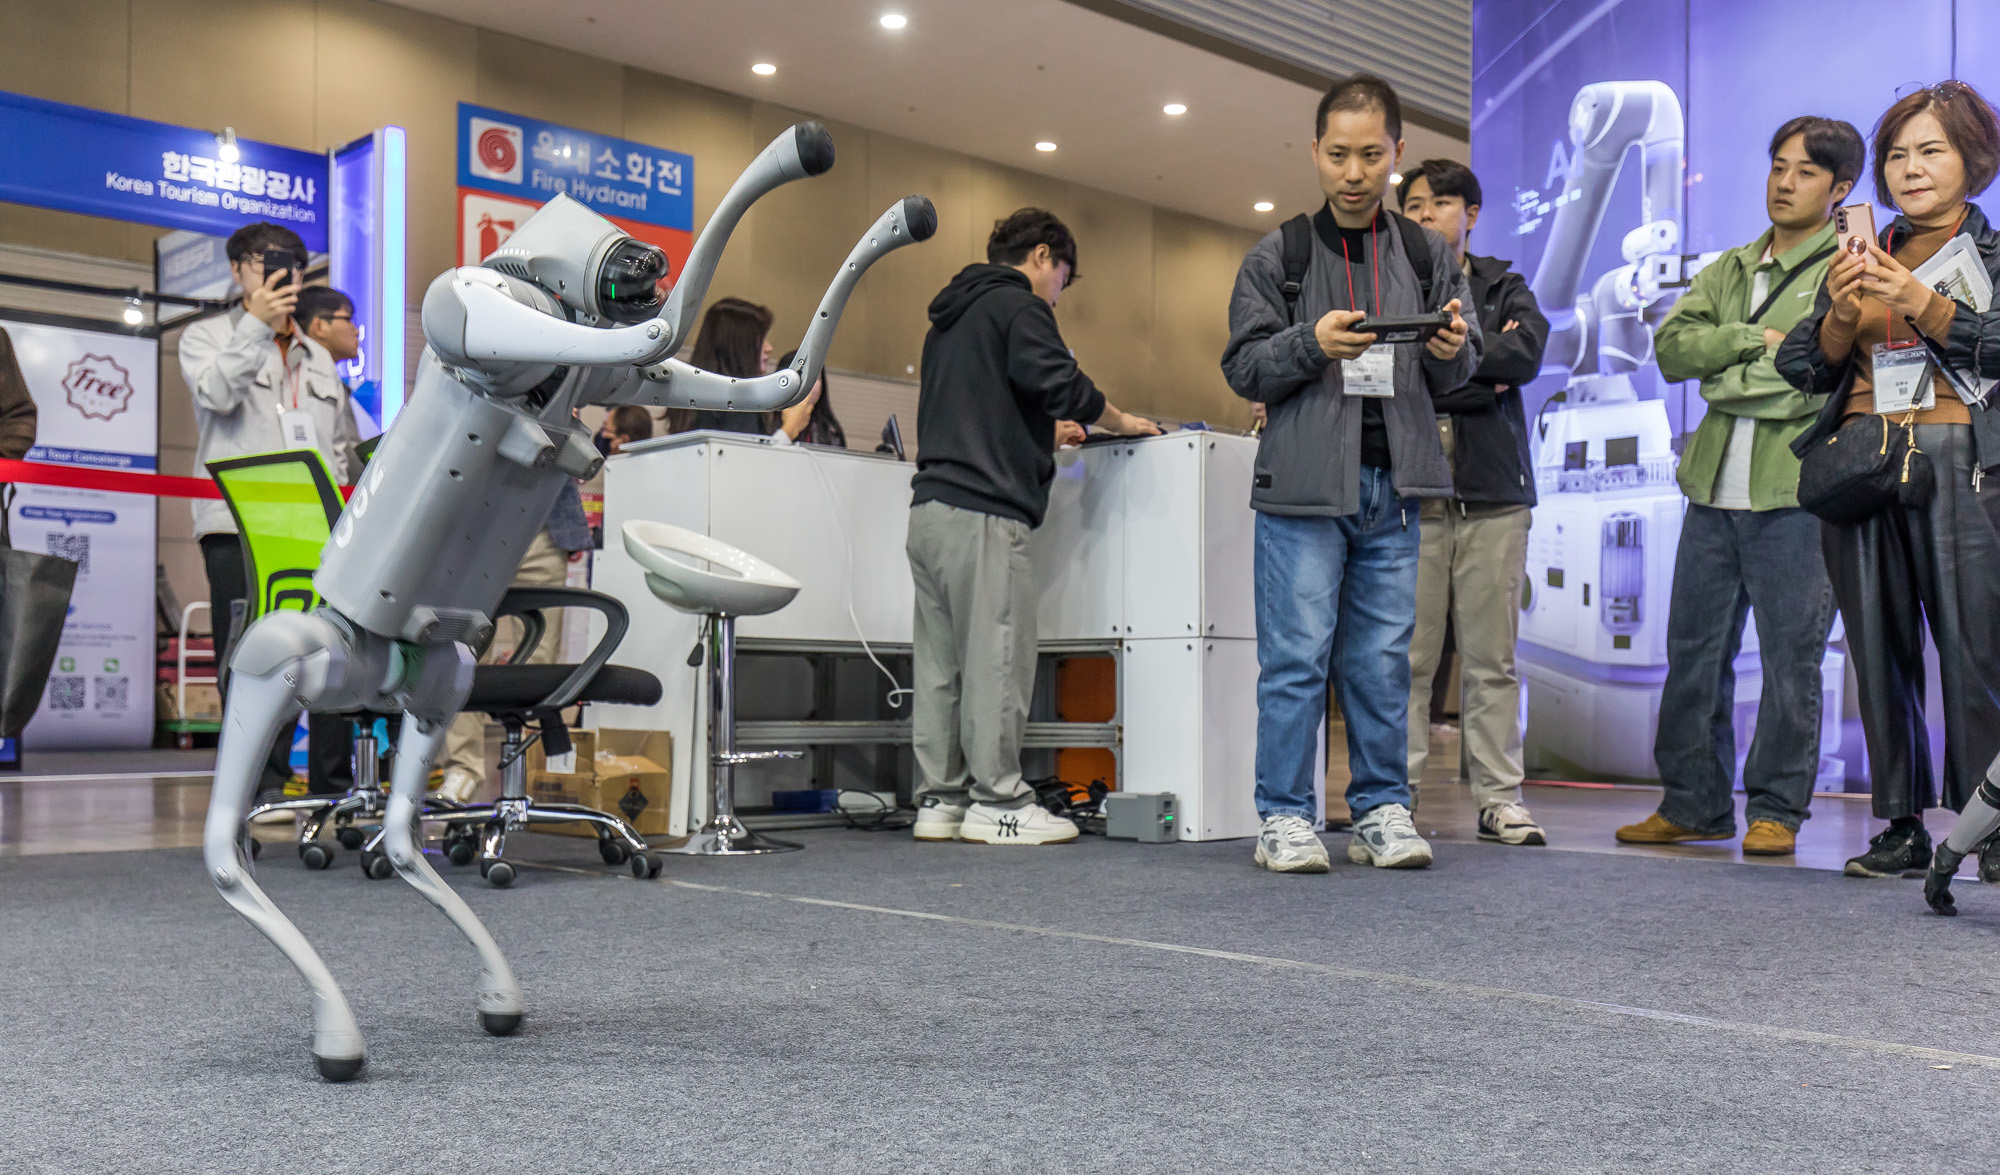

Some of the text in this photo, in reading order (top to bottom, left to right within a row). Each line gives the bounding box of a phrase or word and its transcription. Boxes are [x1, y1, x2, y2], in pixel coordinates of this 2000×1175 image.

[106, 171, 316, 224] Korea Tourism Organization
[162, 150, 316, 205] 한국관광공사
[531, 168, 648, 211] Fire Hydrant
[73, 367, 124, 399] Free
